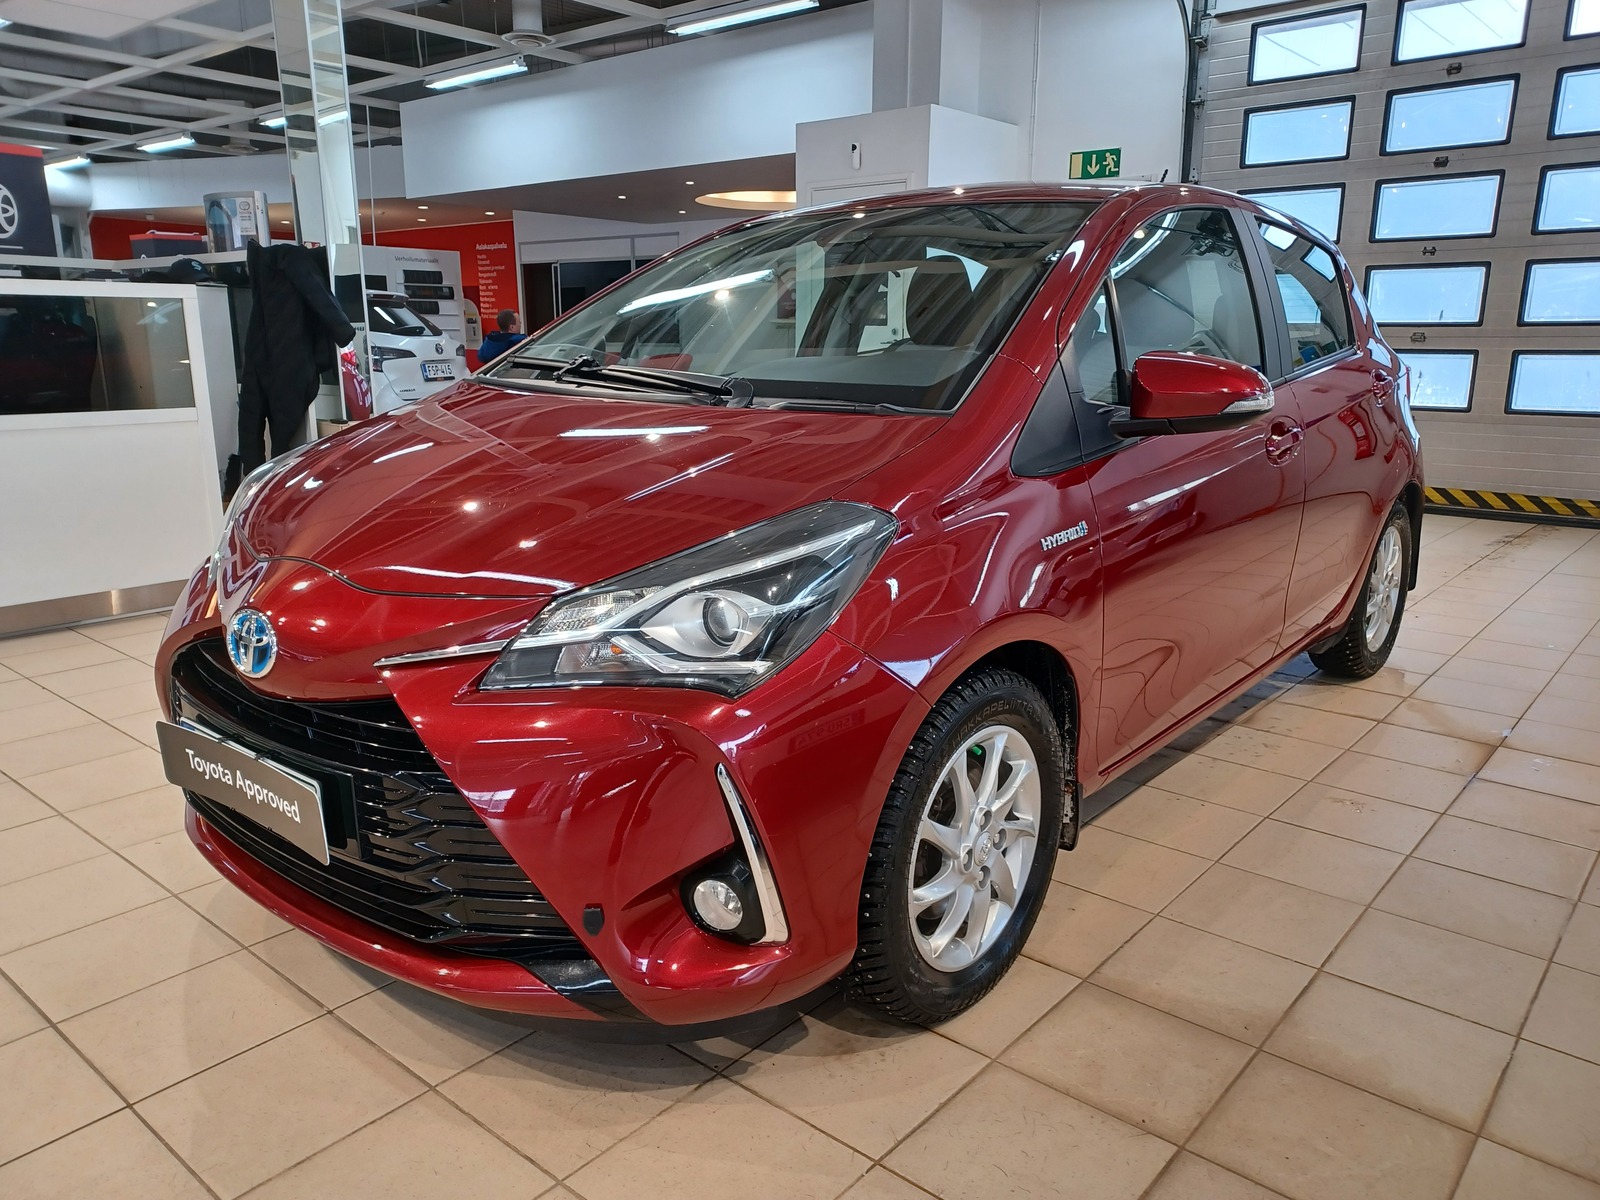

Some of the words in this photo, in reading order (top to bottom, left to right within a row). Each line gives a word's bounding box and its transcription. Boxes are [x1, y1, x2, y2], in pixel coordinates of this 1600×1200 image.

[475, 242, 508, 251] Asiakaspalvelu
[427, 364, 453, 376] FSP-415
[1040, 525, 1081, 551] HYBRID
[951, 699, 1034, 749] HAKKAPELIITTA
[185, 748, 233, 787] Toyota
[236, 769, 301, 824] Approved
